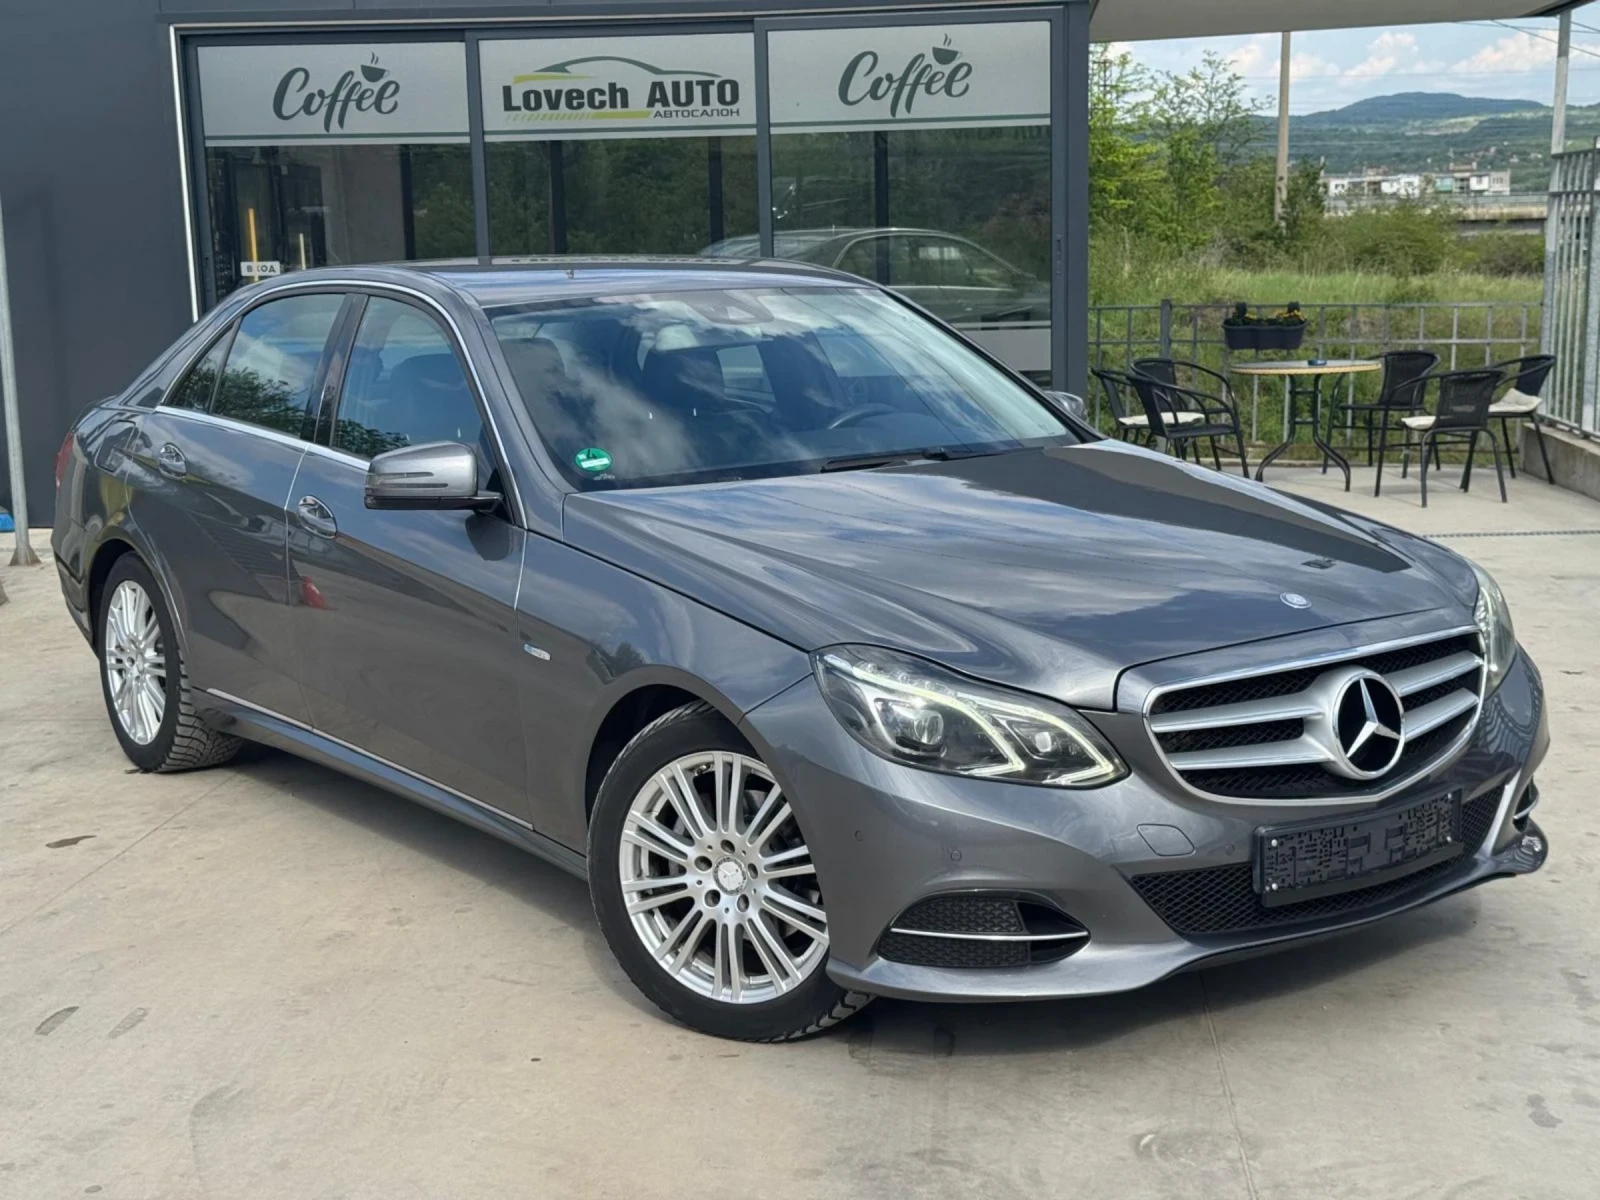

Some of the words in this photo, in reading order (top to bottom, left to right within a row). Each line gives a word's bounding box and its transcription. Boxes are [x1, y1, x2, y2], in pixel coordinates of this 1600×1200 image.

[272, 67, 401, 133] Coffee
[502, 82, 630, 112] Lovech
[646, 78, 740, 109] AUTO
[838, 50, 973, 119] Coffee
[652, 108, 741, 119] АВТОСАЛОН
